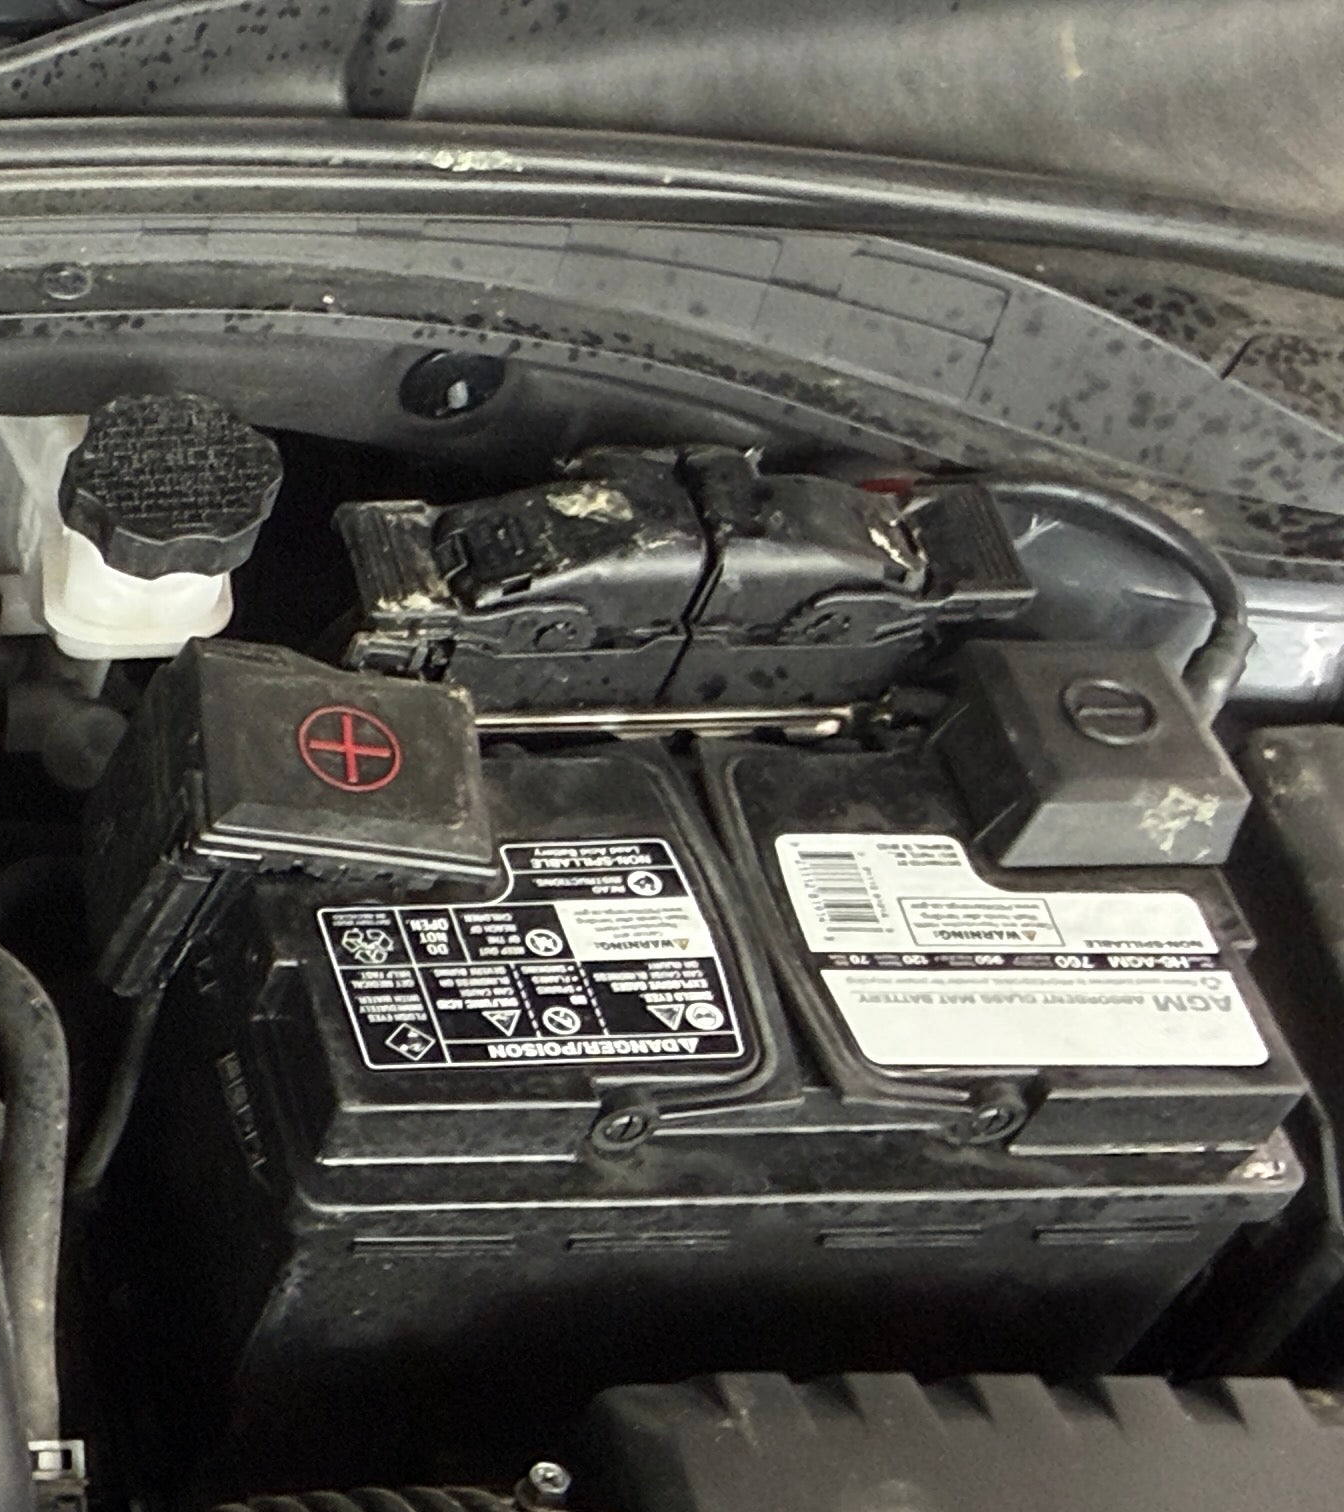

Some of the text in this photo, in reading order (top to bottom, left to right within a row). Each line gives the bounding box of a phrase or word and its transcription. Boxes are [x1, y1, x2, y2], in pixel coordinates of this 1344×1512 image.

[534, 846, 640, 858] Lead Acid Battery
[531, 855, 652, 869] NON-SPILLABLE
[406, 918, 449, 932] OPEN.
[419, 932, 448, 944] NOT
[933, 930, 1021, 941] WARNING:
[425, 944, 449, 956] DO
[593, 940, 674, 951] WARNING:
[1153, 994, 1231, 1013] AGM
[488, 1038, 679, 1059] DANGER/POISON
